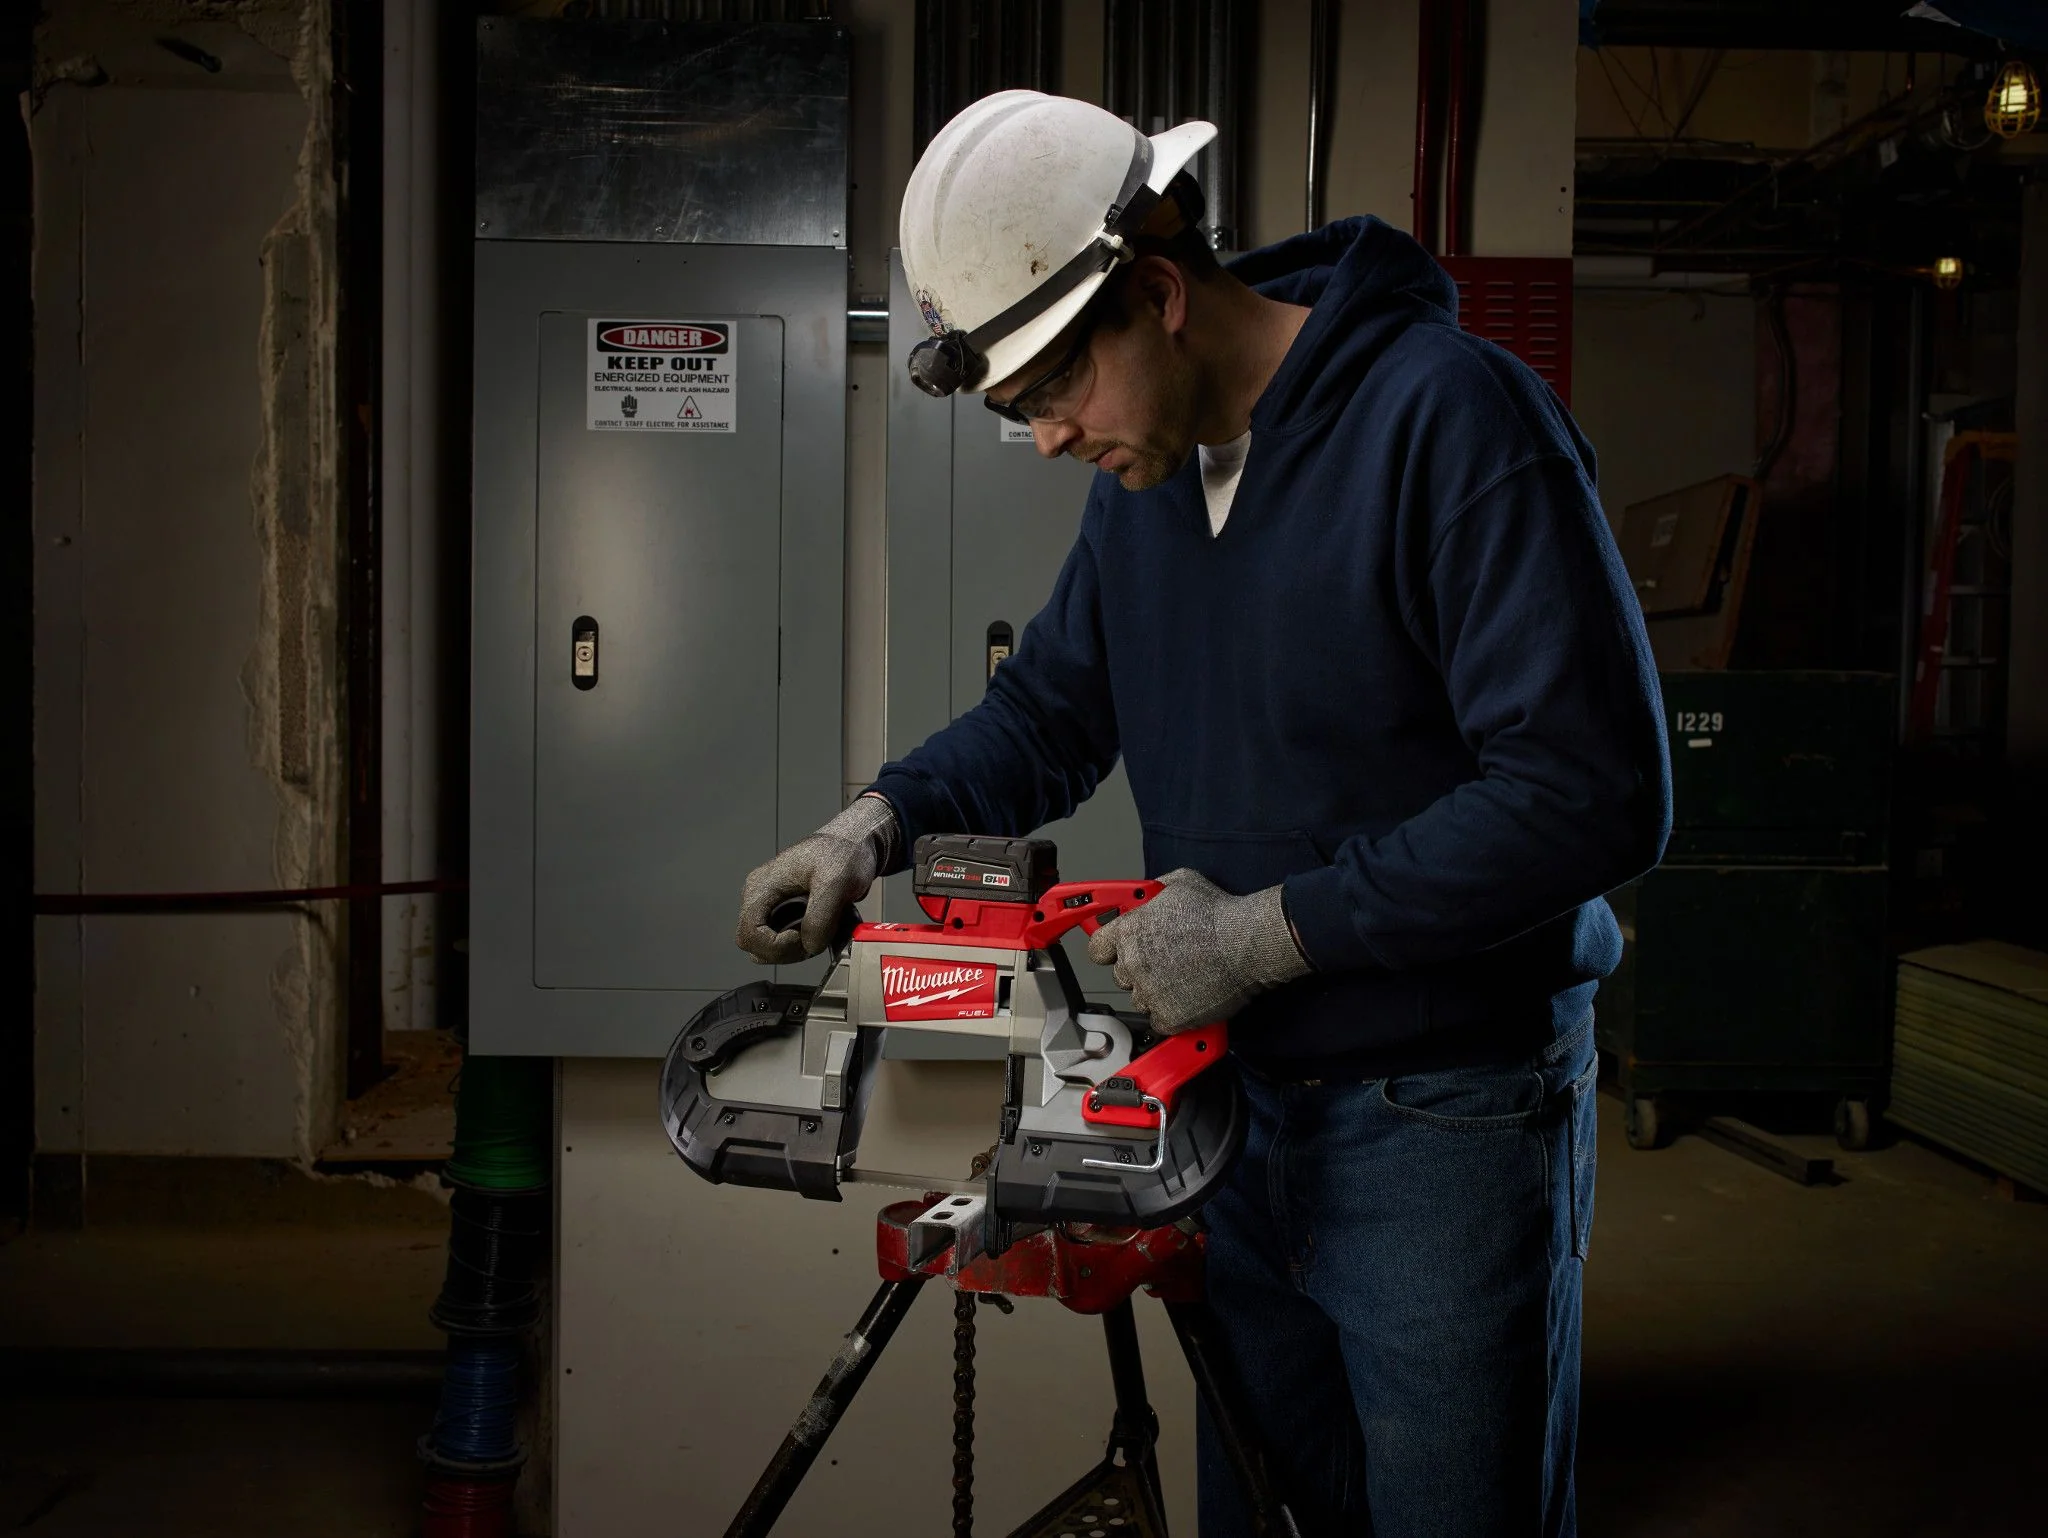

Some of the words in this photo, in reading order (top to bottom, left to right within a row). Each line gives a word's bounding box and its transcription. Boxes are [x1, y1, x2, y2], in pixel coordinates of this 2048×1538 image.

[623, 329, 702, 346] DANGER
[608, 356, 664, 370] KEEP
[671, 357, 717, 371] OUT
[594, 372, 660, 382] ENERGIZED
[663, 373, 730, 383] EQUIPMENT
[1677, 711, 1724, 733] 1229
[984, 874, 1009, 885] M18
[882, 965, 985, 996] Milwaukee
